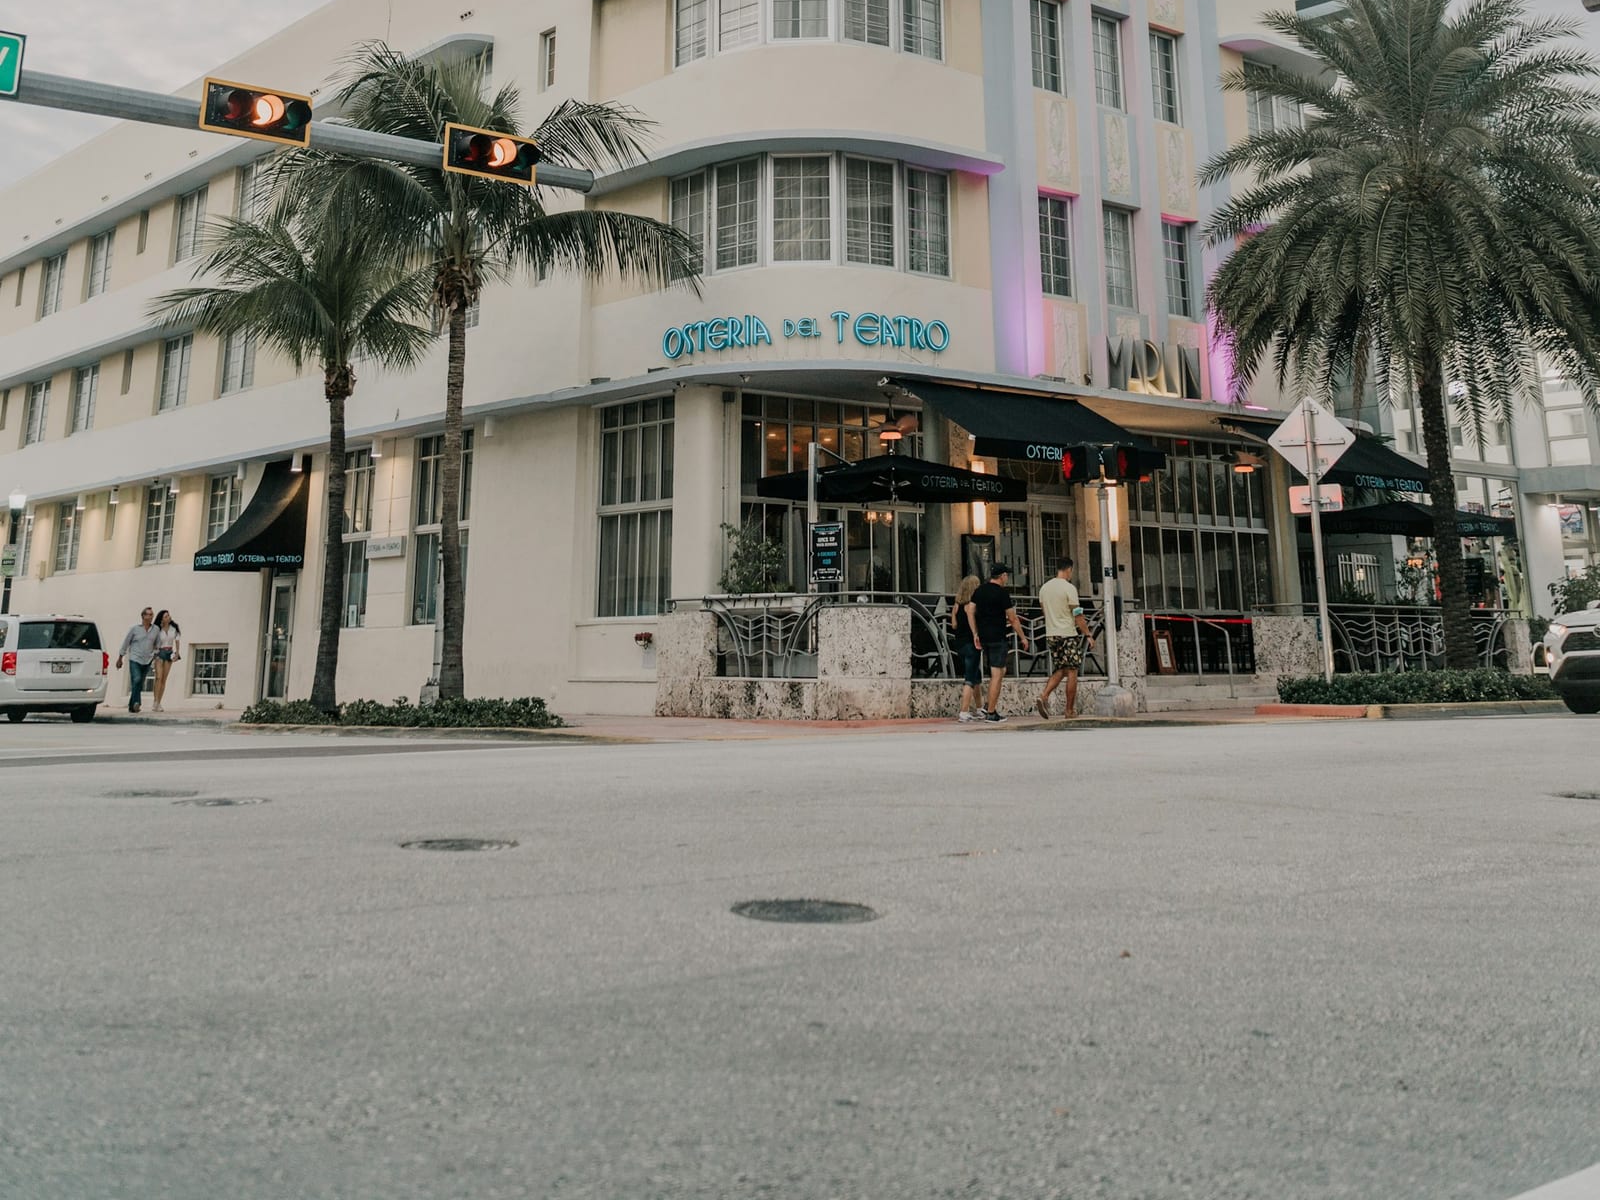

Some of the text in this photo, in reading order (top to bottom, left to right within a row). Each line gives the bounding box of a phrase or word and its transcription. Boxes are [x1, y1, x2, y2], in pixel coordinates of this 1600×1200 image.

[663, 310, 949, 359] OSTERIA DEL TEATRO
[1106, 336, 1201, 399] MARLIN
[1026, 444, 1064, 461] OSTERI
[921, 475, 958, 489] OSTERIA
[971, 478, 1003, 494] TEATRO
[1355, 474, 1386, 489] OSTERIA
[1394, 478, 1424, 492] TEATRO
[238, 554, 266, 563] OSTERIA
[275, 555, 302, 563] TEATRO
